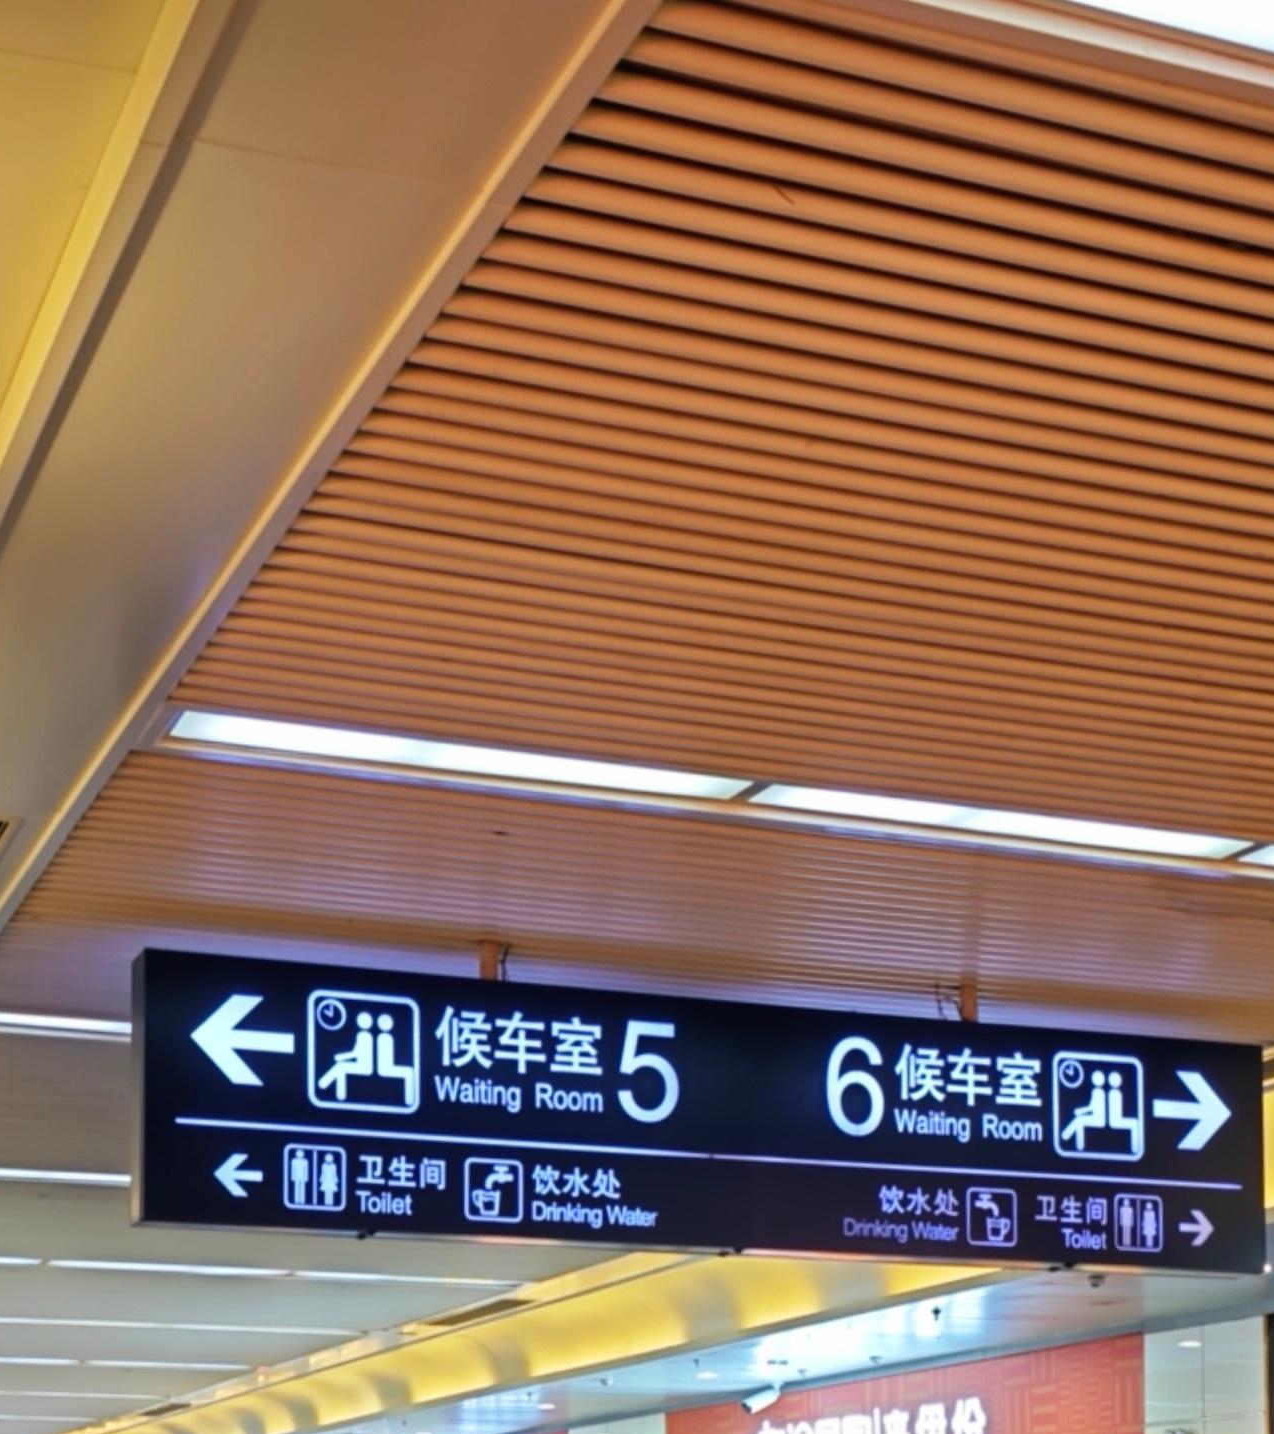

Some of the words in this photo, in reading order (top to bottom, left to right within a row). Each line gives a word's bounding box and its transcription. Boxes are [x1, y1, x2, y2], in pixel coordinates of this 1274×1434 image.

[434, 1007, 603, 1077] 候车室
[618, 1020, 679, 1123] 5
[826, 1036, 885, 1137] 6
[895, 1044, 1043, 1107] 候车室
[434, 1075, 521, 1113] Waiting
[535, 1083, 603, 1113] Room
[894, 1108, 970, 1143] Waiting
[983, 1114, 1043, 1142] Room
[357, 1155, 447, 1191] 卫生间
[532, 1165, 621, 1199] 饮水处
[355, 1190, 412, 1216] Toilet
[532, 1201, 603, 1229] Drinking
[606, 1205, 658, 1227] Water
[878, 1185, 958, 1216] 饮水处
[1034, 1195, 1108, 1225] 卫生间
[843, 1217, 908, 1242] Drinking
[912, 1220, 958, 1241] Water
[1061, 1228, 1107, 1250] Toilet
